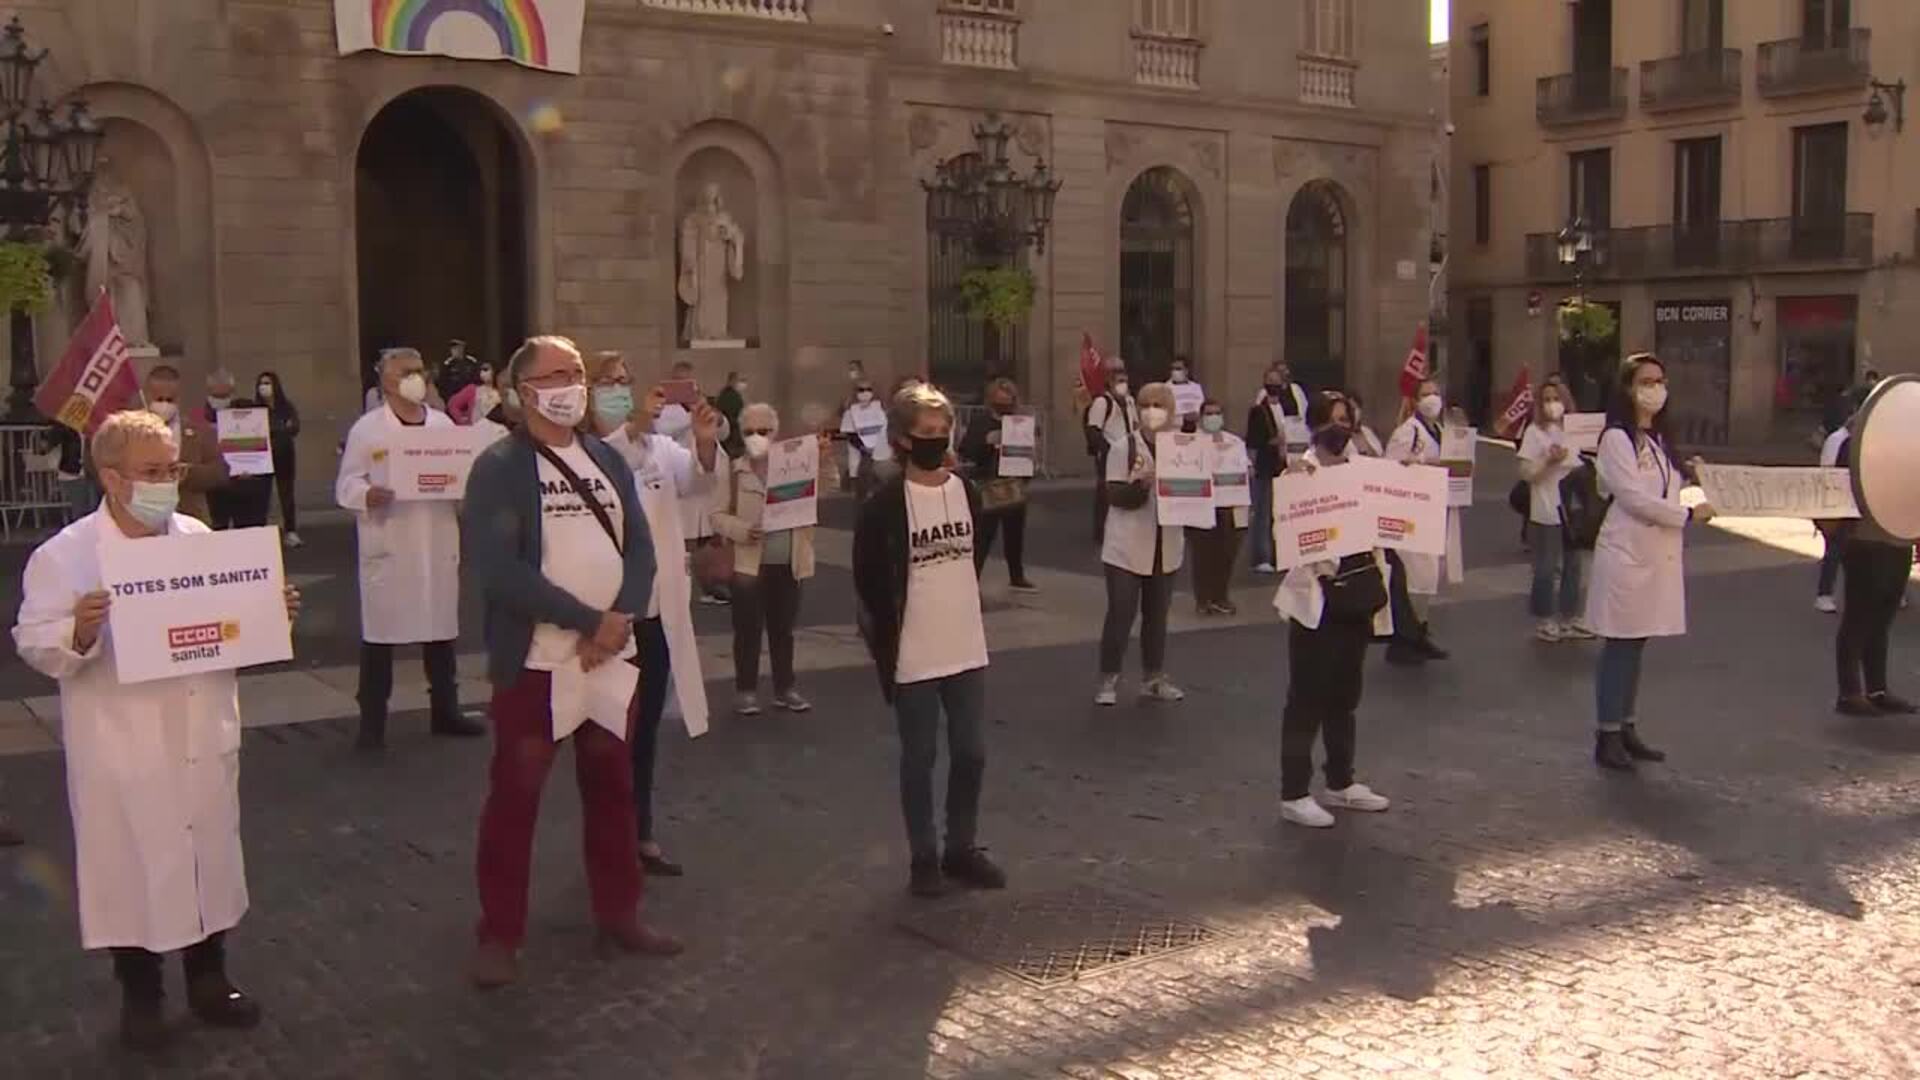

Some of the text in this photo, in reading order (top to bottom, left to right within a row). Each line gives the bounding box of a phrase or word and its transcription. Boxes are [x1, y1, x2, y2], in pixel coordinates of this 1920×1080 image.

[1656, 306, 1728, 322] BCN CORNER
[540, 478, 606, 495] MAEA
[112, 568, 269, 596] TOTES SOM SANITAT
[170, 625, 221, 647] CCOO
[171, 645, 220, 662] sanitat
